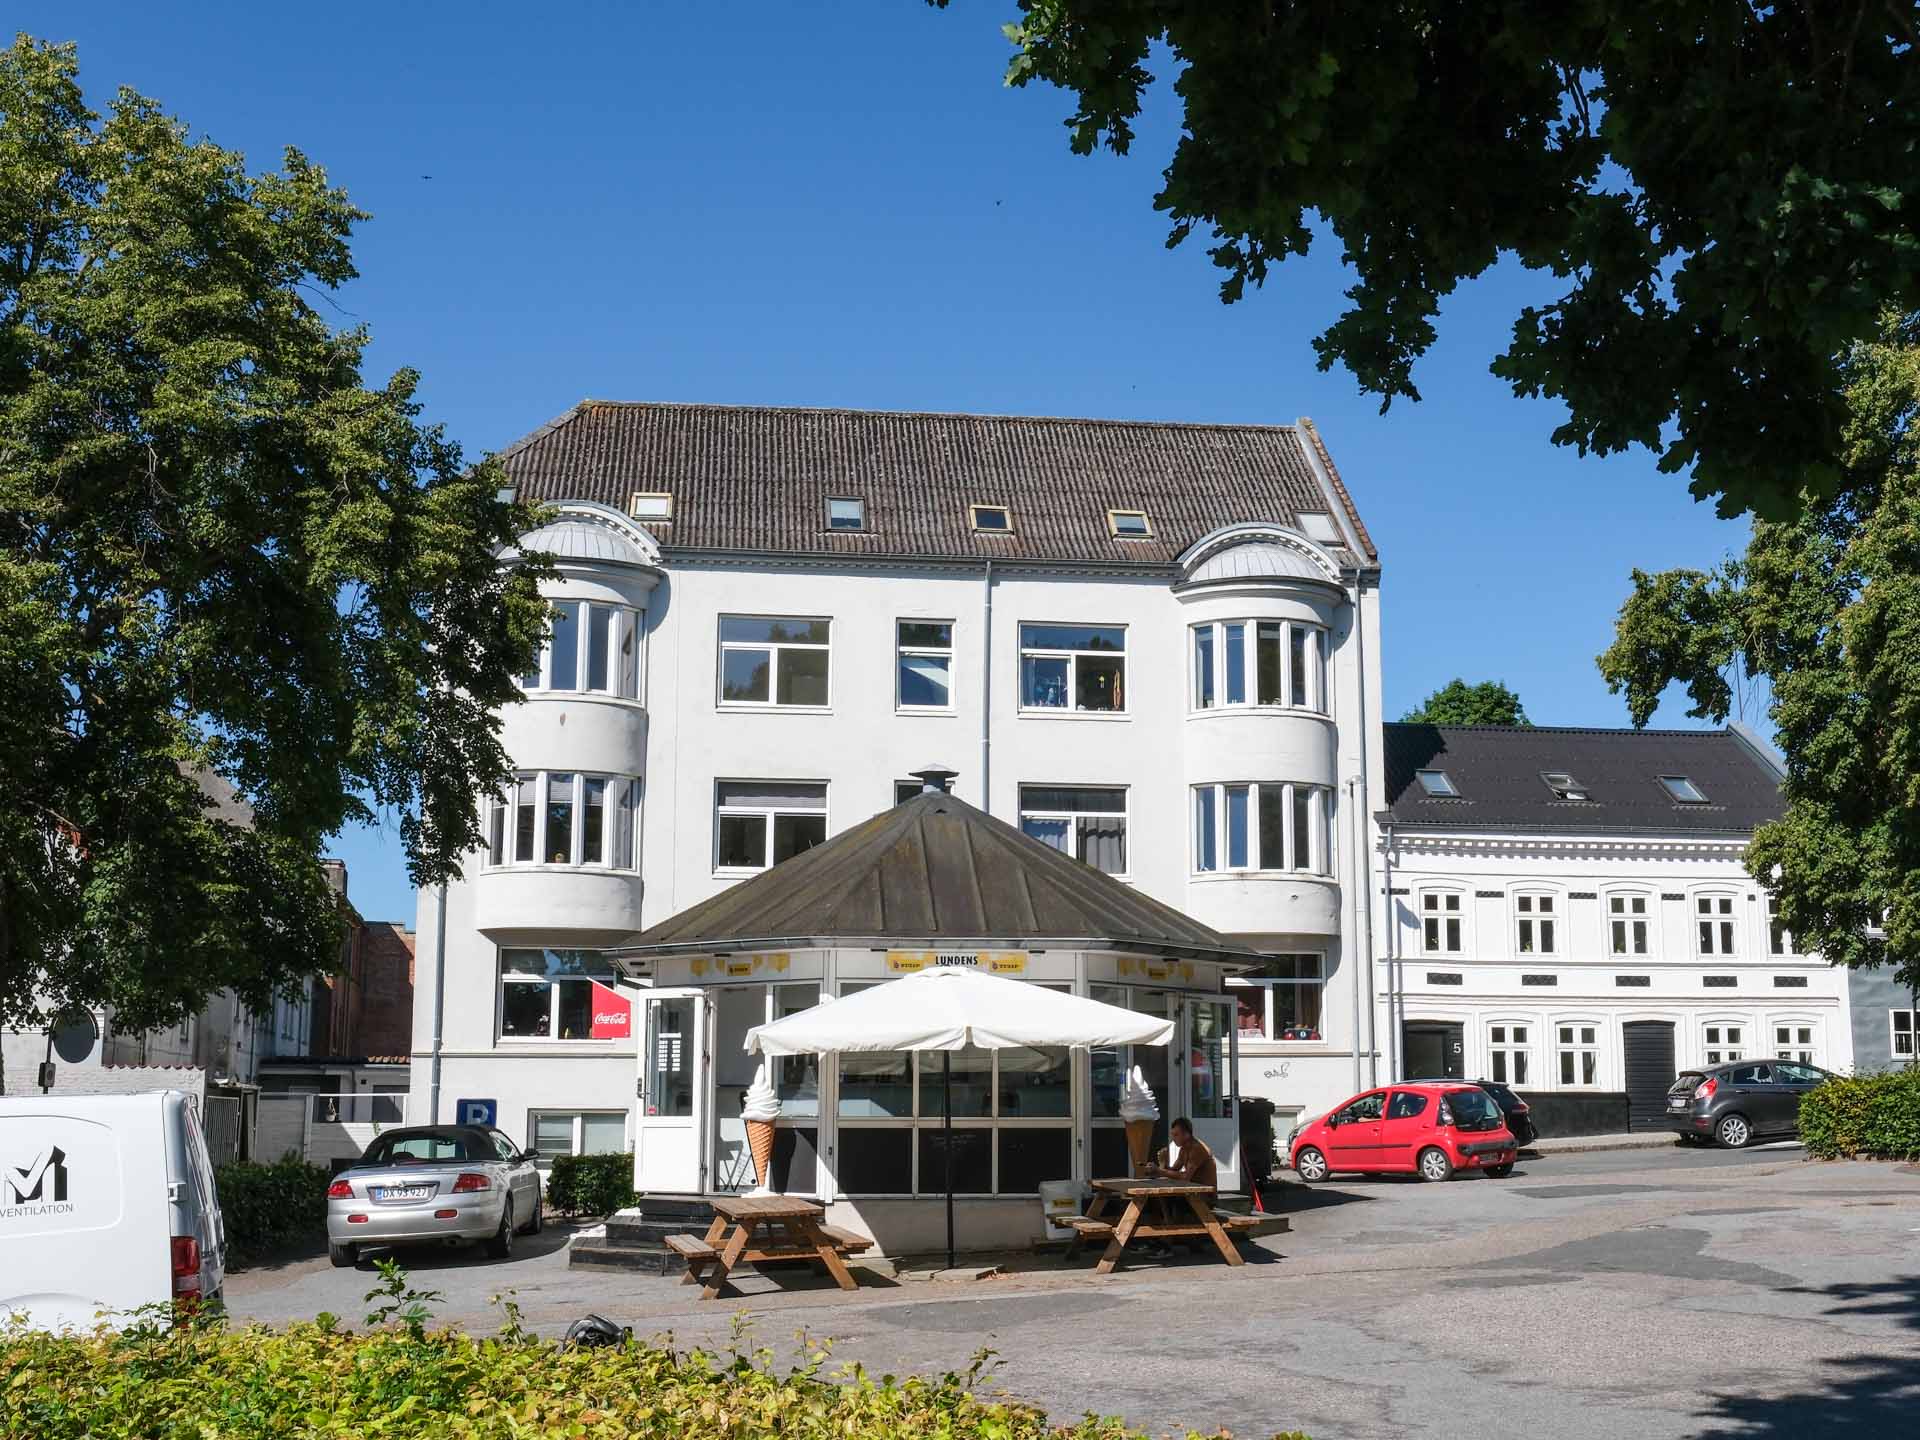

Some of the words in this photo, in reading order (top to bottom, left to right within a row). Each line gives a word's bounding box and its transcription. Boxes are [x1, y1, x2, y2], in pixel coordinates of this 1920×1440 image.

[935, 955, 978, 966] LUNDENS
[1453, 1042, 1462, 1054] 5
[466, 1103, 489, 1124] P
[0, 1203, 74, 1218] VENTILATION
